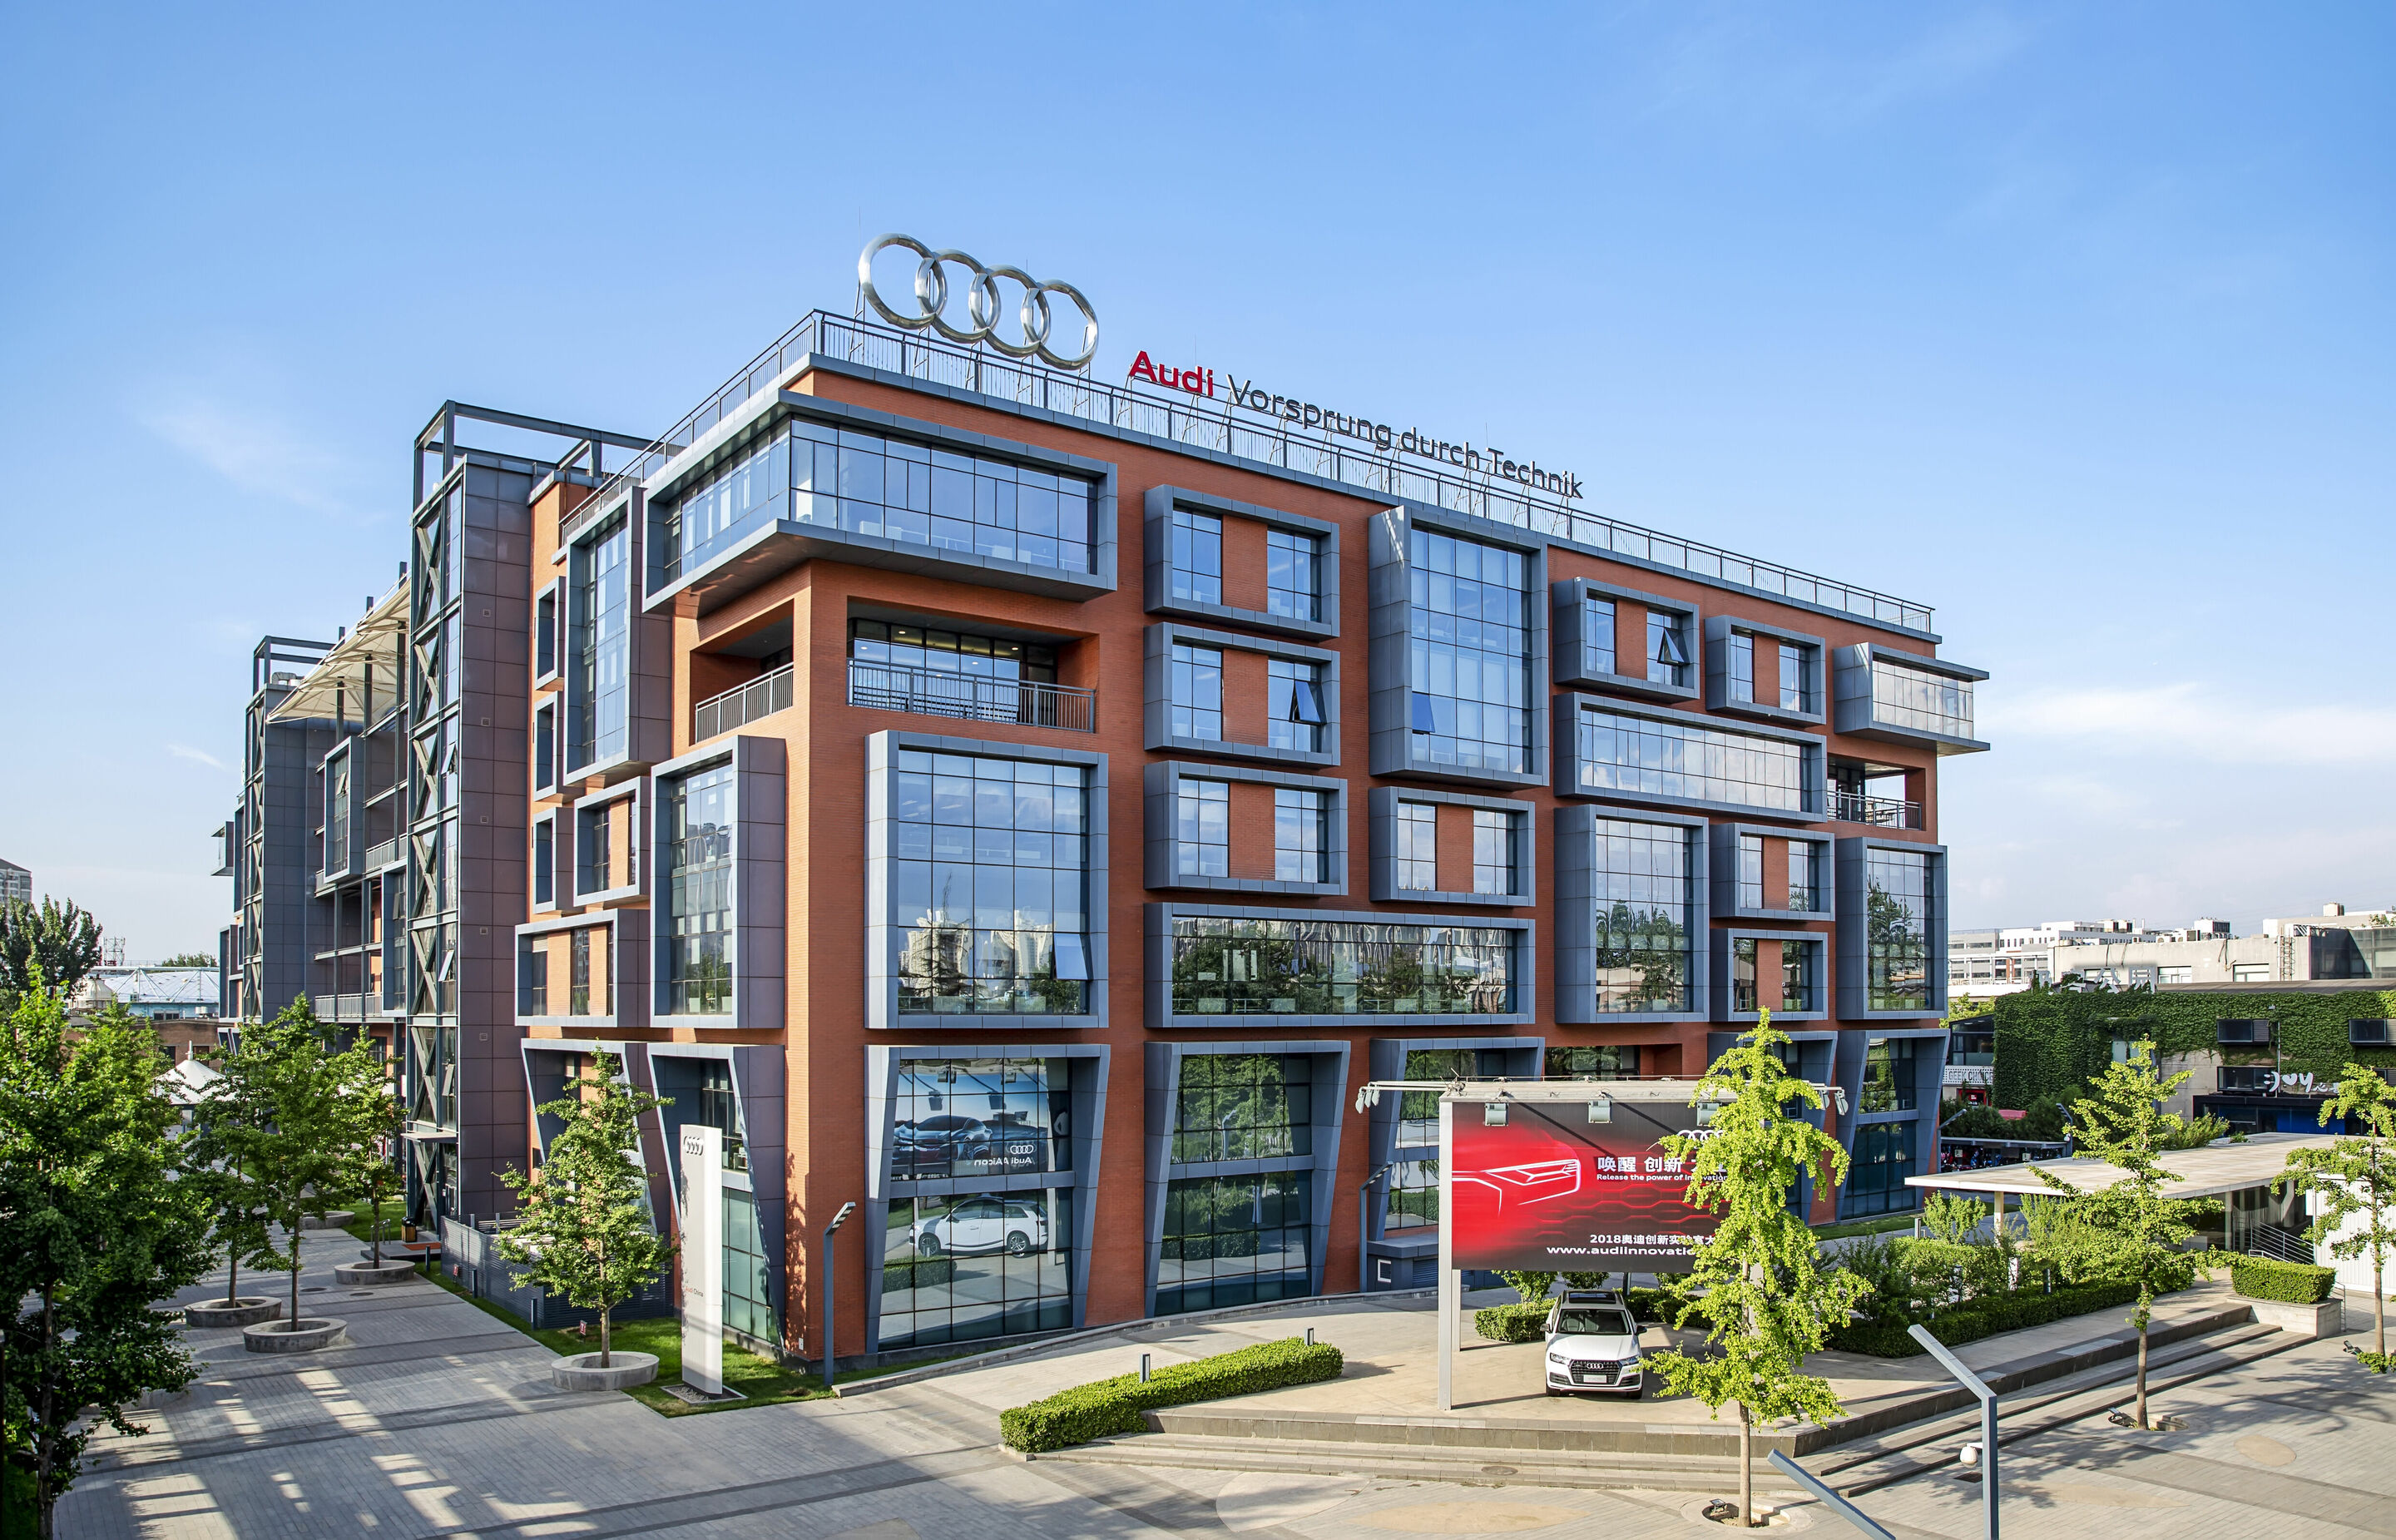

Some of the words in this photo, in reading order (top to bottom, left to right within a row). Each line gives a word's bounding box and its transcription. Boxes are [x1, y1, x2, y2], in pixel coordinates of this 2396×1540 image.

[1129, 350, 1214, 398] Audi
[1226, 374, 1391, 451] Vorsprung
[1399, 427, 1479, 471] durch
[1486, 447, 1583, 499] Technik
[1948, 1071, 1967, 1081] GEEK
[1968, 1071, 1993, 1081] CHOICE
[1597, 1156, 1636, 1172] 唤醒
[1644, 1156, 1683, 1172] 创新
[1546, 1246, 1700, 1255] www.audiinnovatio
